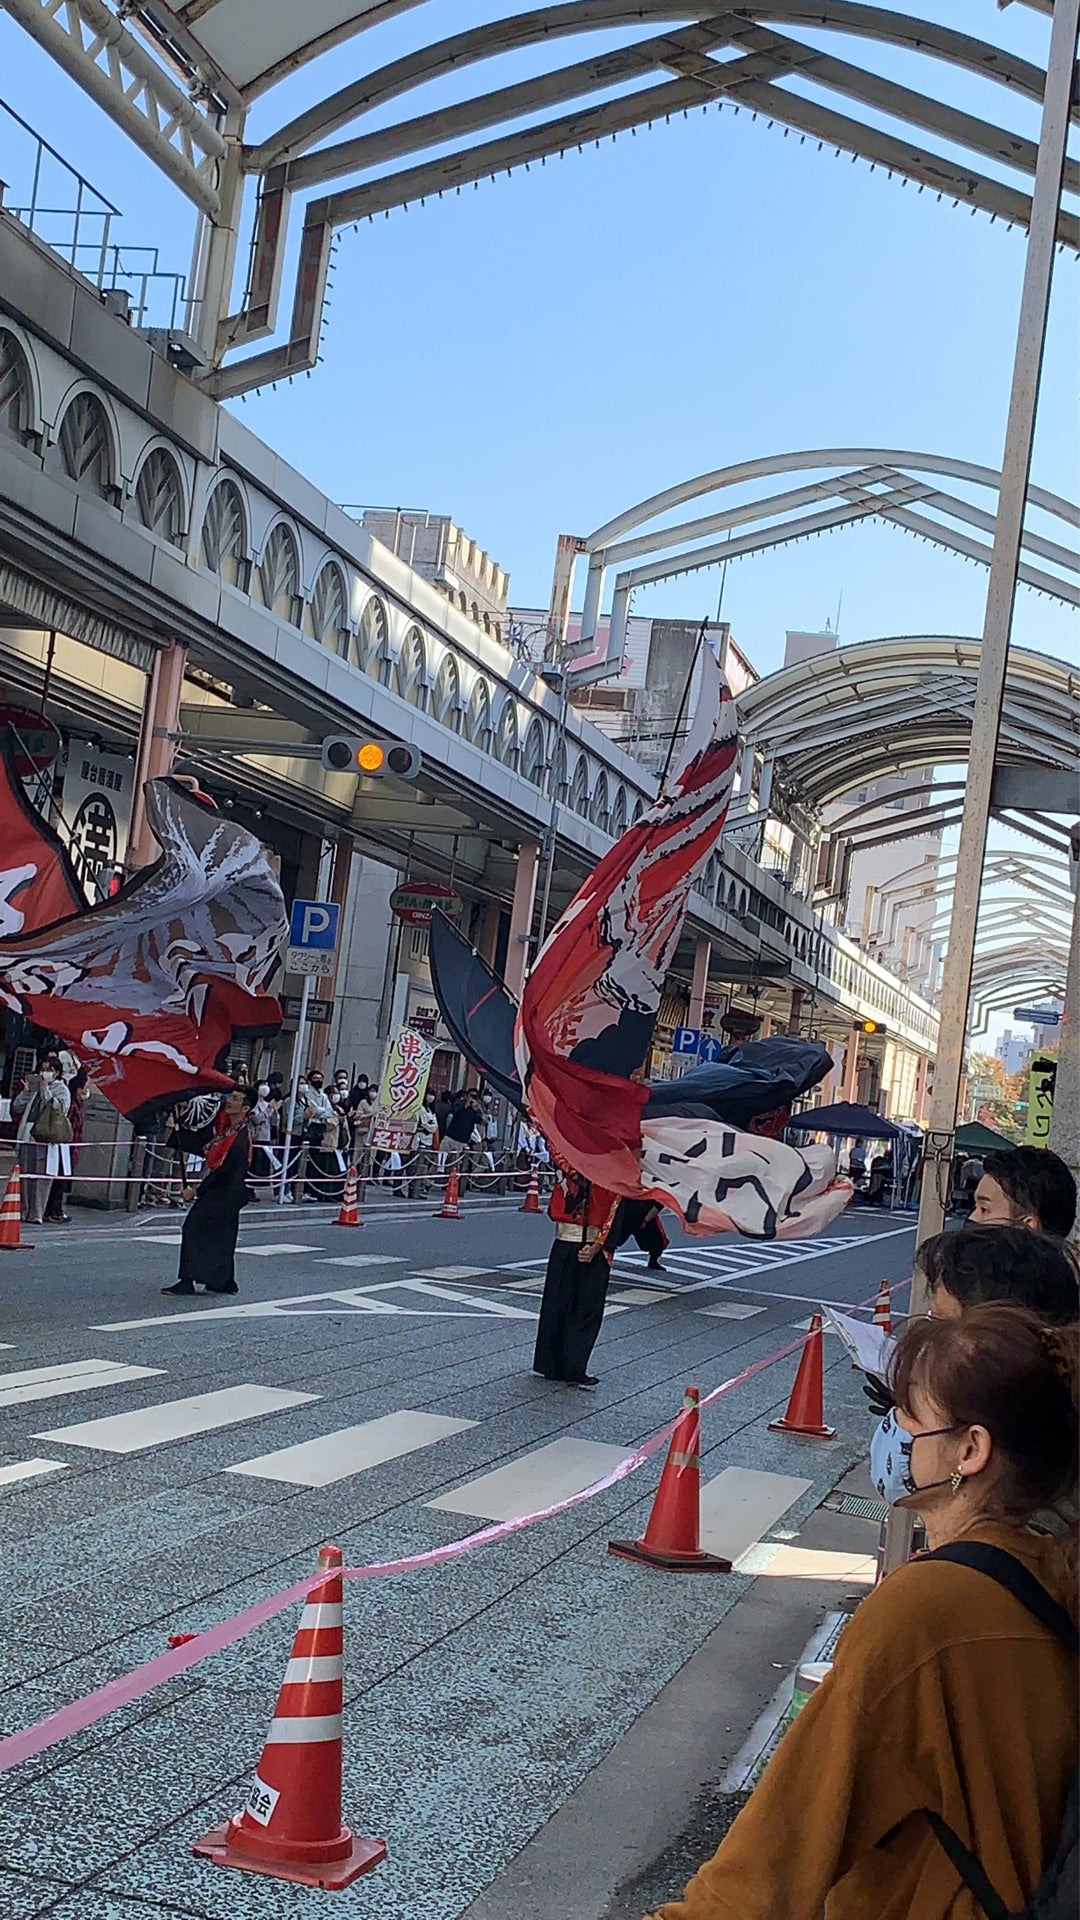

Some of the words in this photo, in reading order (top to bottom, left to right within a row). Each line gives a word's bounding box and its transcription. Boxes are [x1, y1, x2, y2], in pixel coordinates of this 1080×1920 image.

[80, 760, 124, 793] 屋台居酒屋
[301, 906, 330, 943] P
[290, 961, 330, 974] ここから
[680, 1030, 696, 1050] P
[390, 1031, 422, 1112] 串カツ
[372, 1130, 412, 1151] 名物
